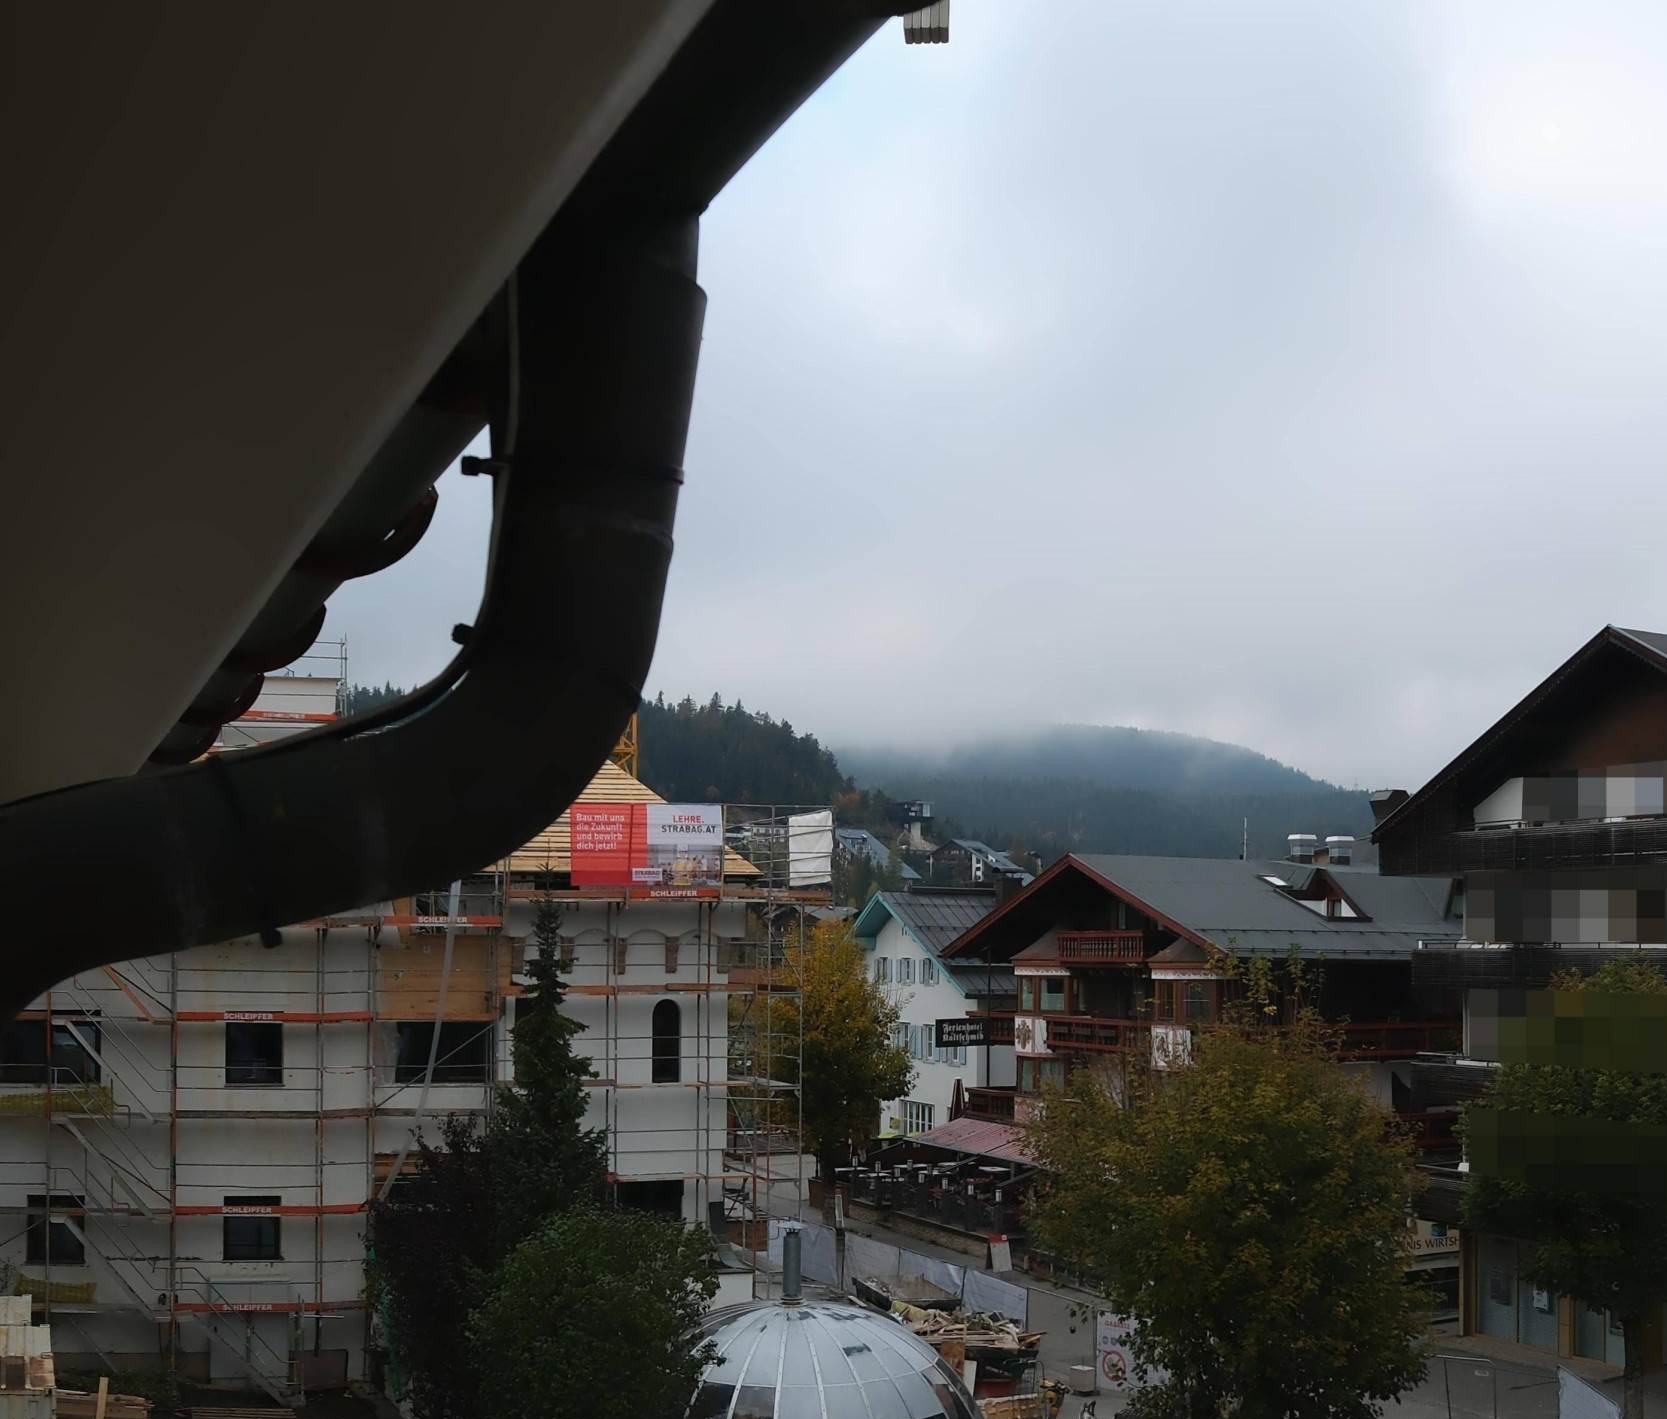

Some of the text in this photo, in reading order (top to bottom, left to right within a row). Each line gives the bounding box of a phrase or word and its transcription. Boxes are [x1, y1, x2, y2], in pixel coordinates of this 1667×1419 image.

[576, 813, 592, 821] Bau
[594, 813, 608, 821] mit
[673, 815, 705, 823] LEHRE.
[576, 823, 623, 831] die Zukunft
[661, 825, 716, 833] STRABAG.AT
[576, 832, 623, 841] und bewirb
[576, 842, 617, 851] dich jetzt!
[222, 1206, 272, 1214] SCHLEIPFER
[1424, 1236, 1460, 1249] WIRTSH
